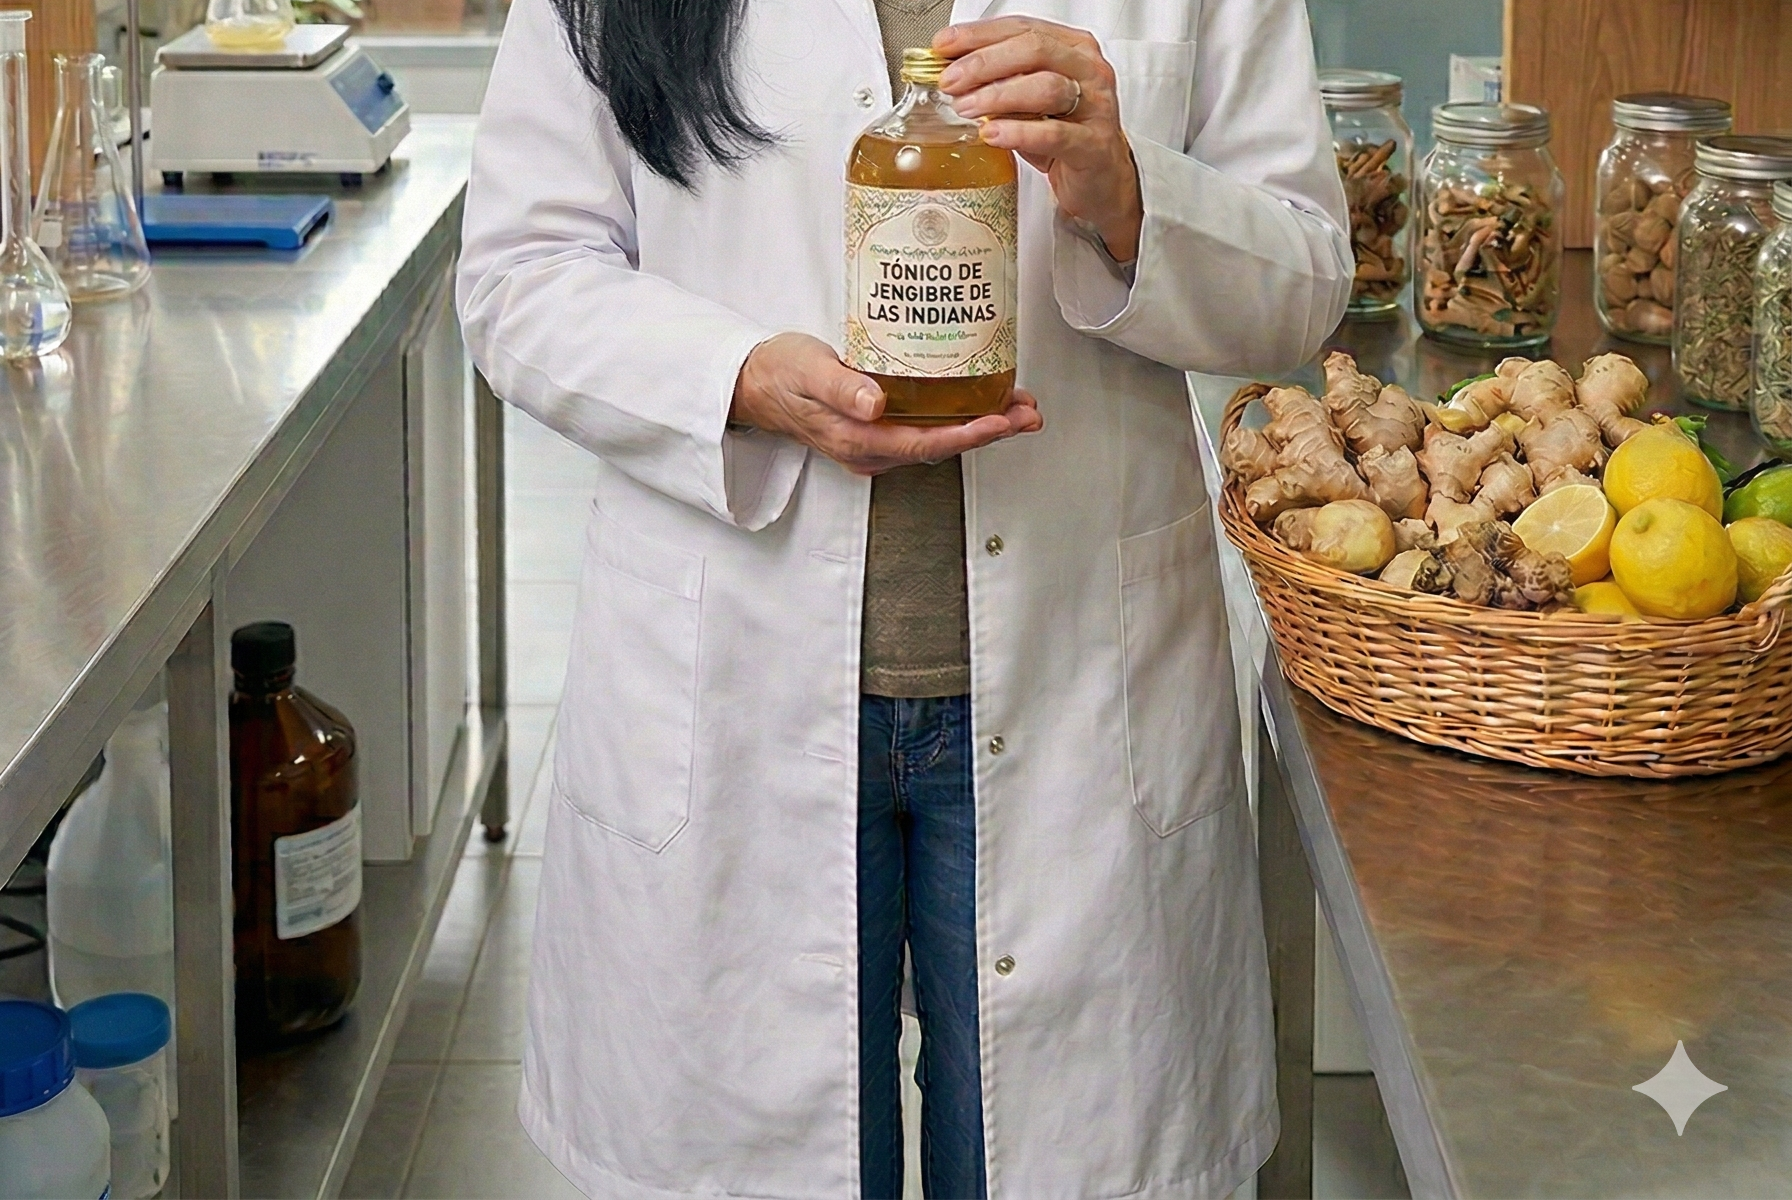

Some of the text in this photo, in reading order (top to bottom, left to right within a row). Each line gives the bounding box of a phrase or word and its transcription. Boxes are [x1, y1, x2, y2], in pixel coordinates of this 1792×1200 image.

[879, 258, 983, 281] TÓNICO DE
[869, 282, 992, 302] JENGIBRE DE
[867, 302, 997, 325] LAS INDIANAS
